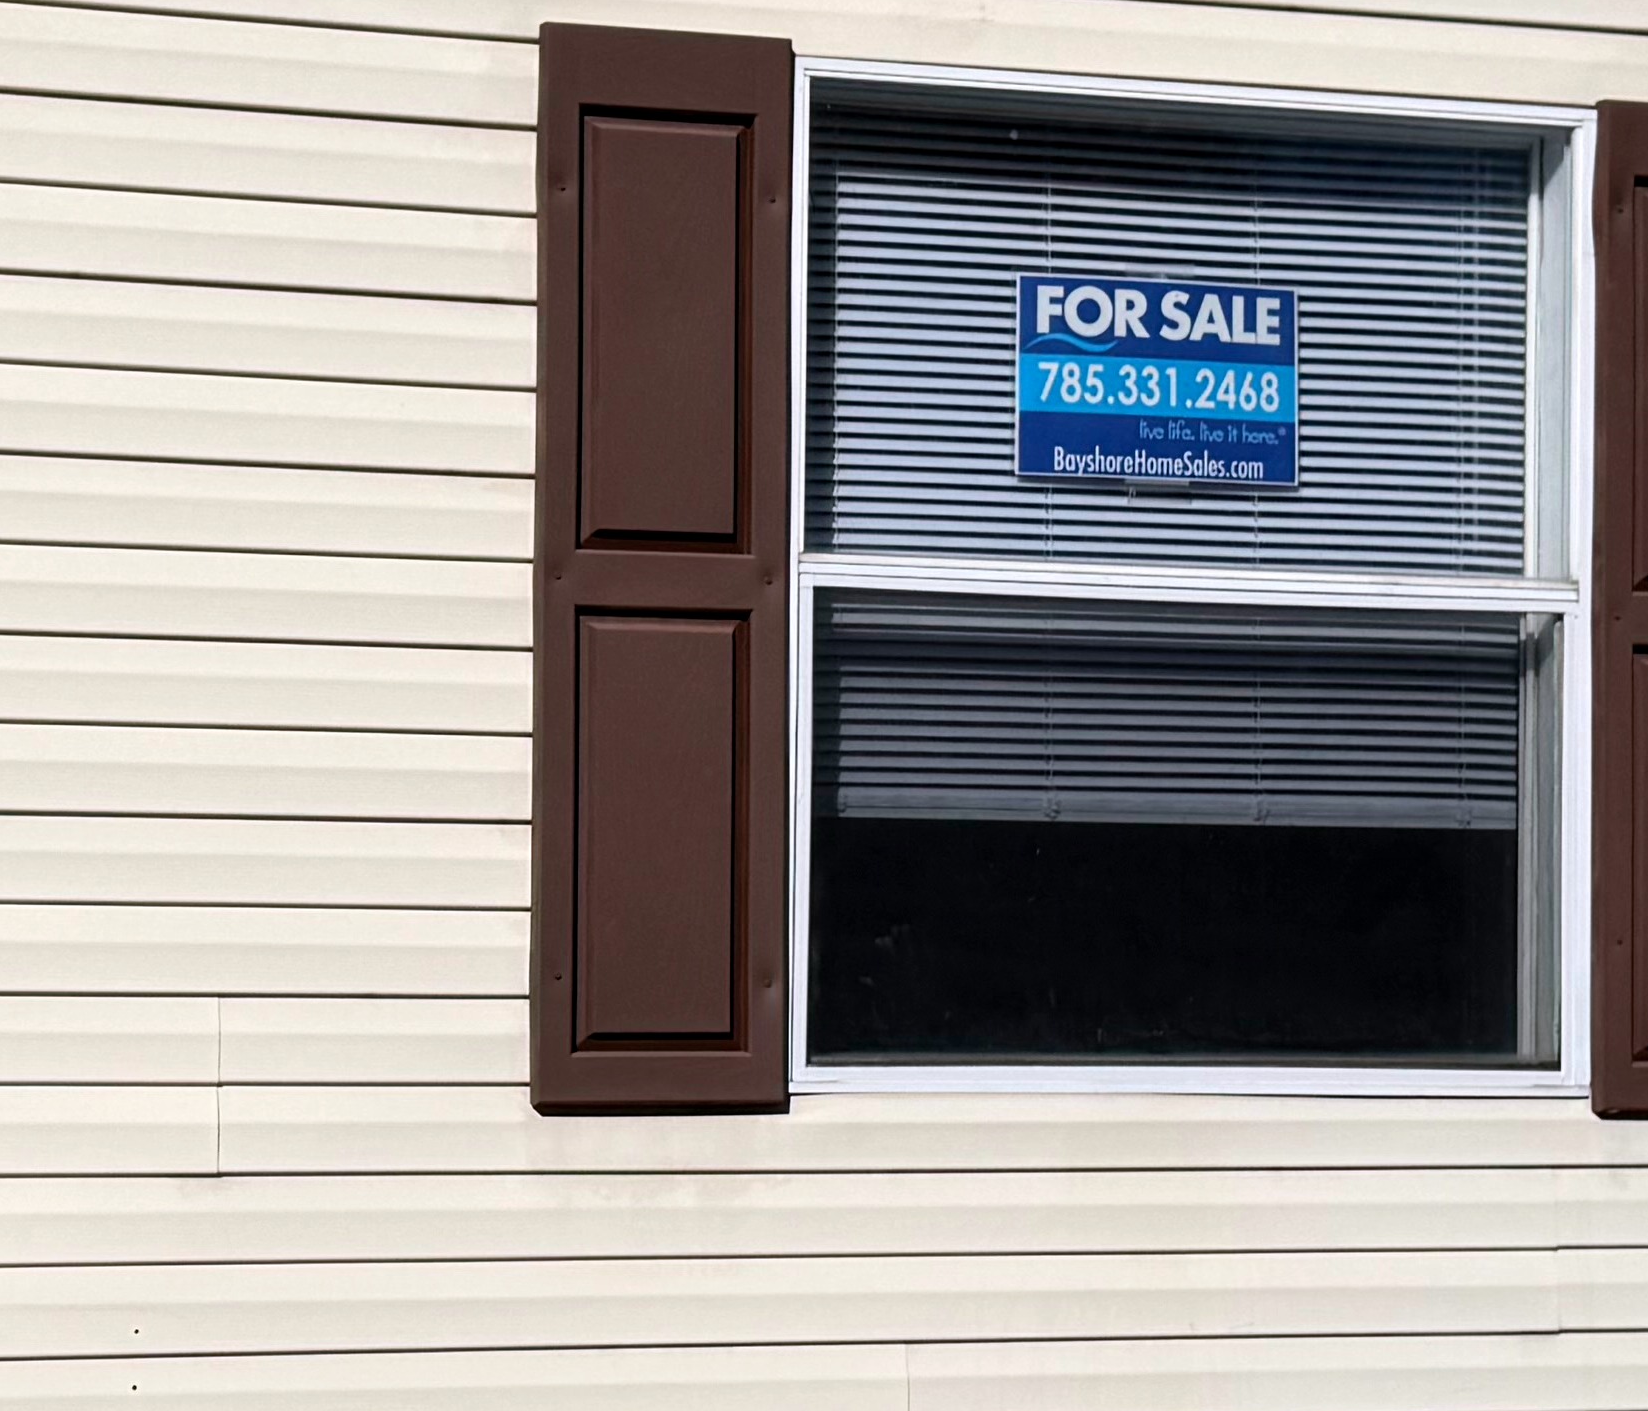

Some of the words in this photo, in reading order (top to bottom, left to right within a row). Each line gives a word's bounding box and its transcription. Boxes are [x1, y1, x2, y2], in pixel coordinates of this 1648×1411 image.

[1036, 285, 1150, 338] FOR
[1159, 290, 1281, 346] SALE
[1038, 362, 1280, 413] 785.331.2468
[1139, 419, 1164, 440] live
[1199, 421, 1224, 442] live
[1228, 425, 1238, 443] it
[1054, 445, 1264, 479] BayshoreHomeSales.com
